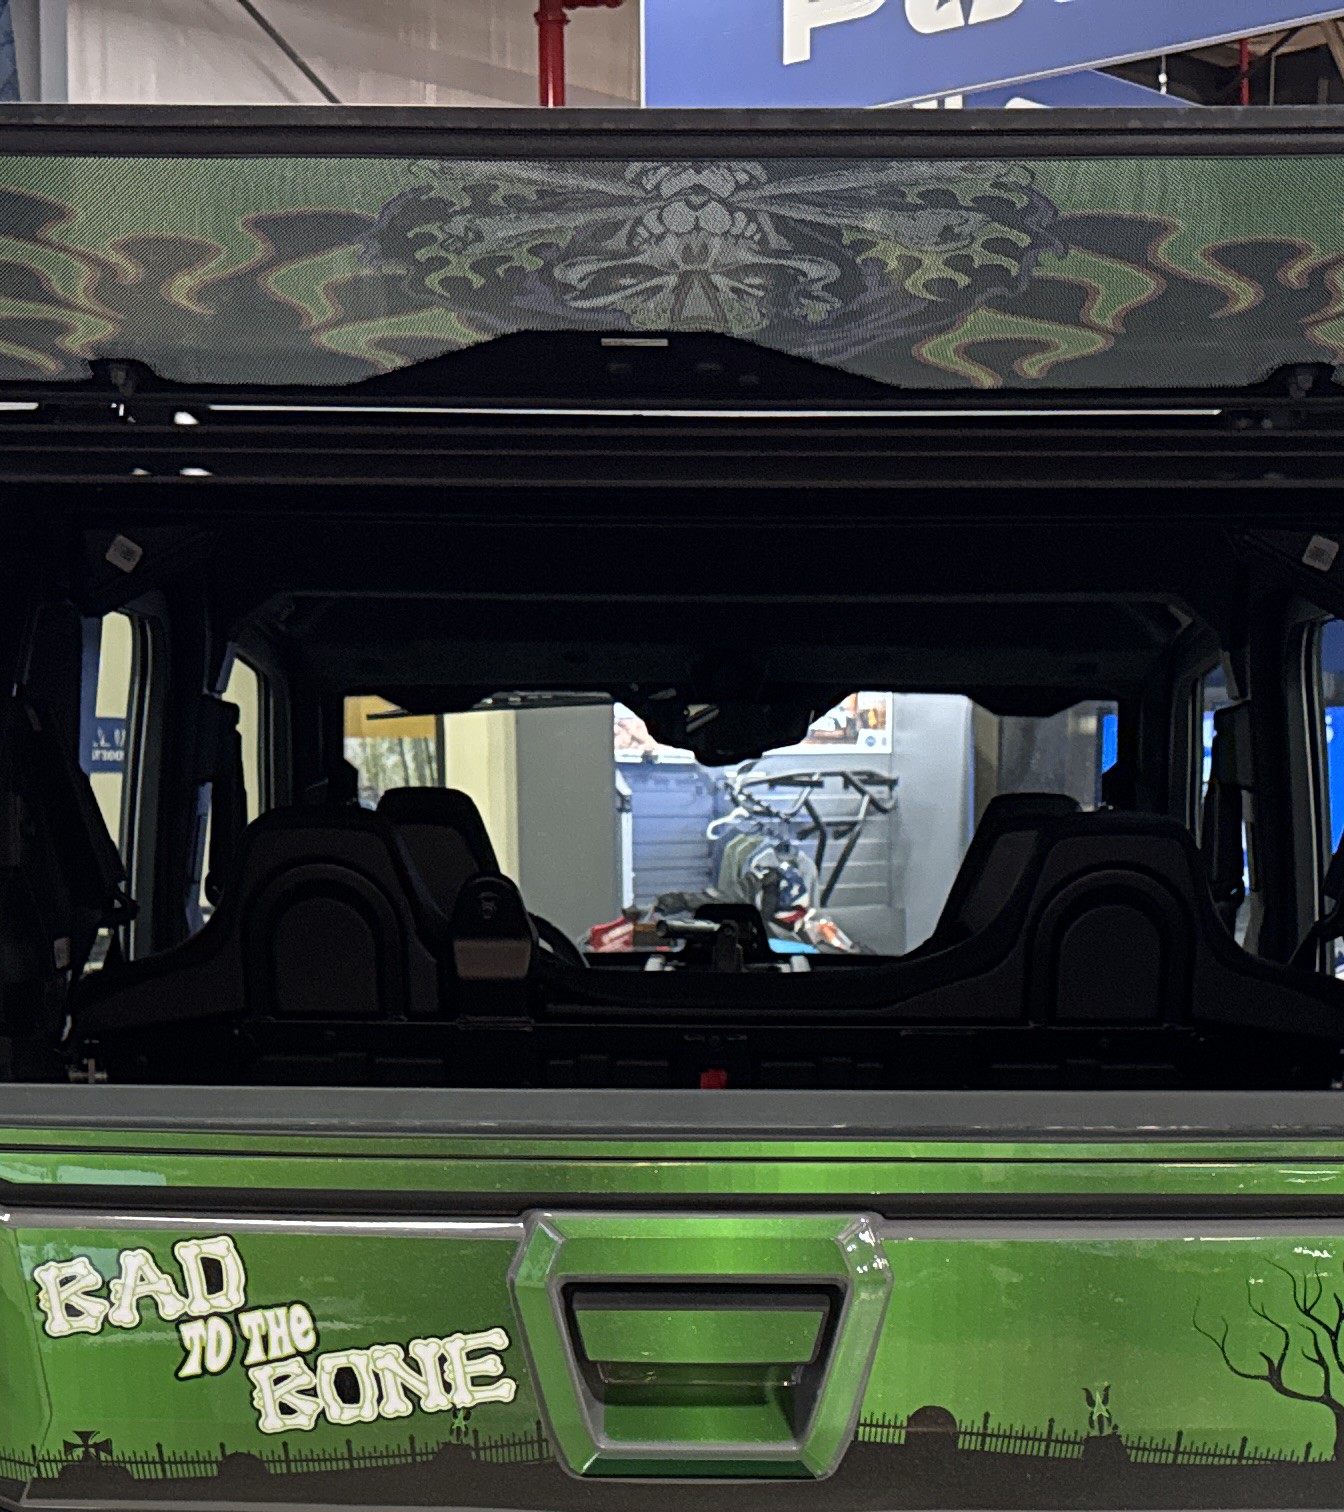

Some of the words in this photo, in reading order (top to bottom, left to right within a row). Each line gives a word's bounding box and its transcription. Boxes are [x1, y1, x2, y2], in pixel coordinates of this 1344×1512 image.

[32, 1234, 250, 1338] BAD
[177, 1314, 237, 1380] TO
[248, 1326, 520, 1435] BONE
